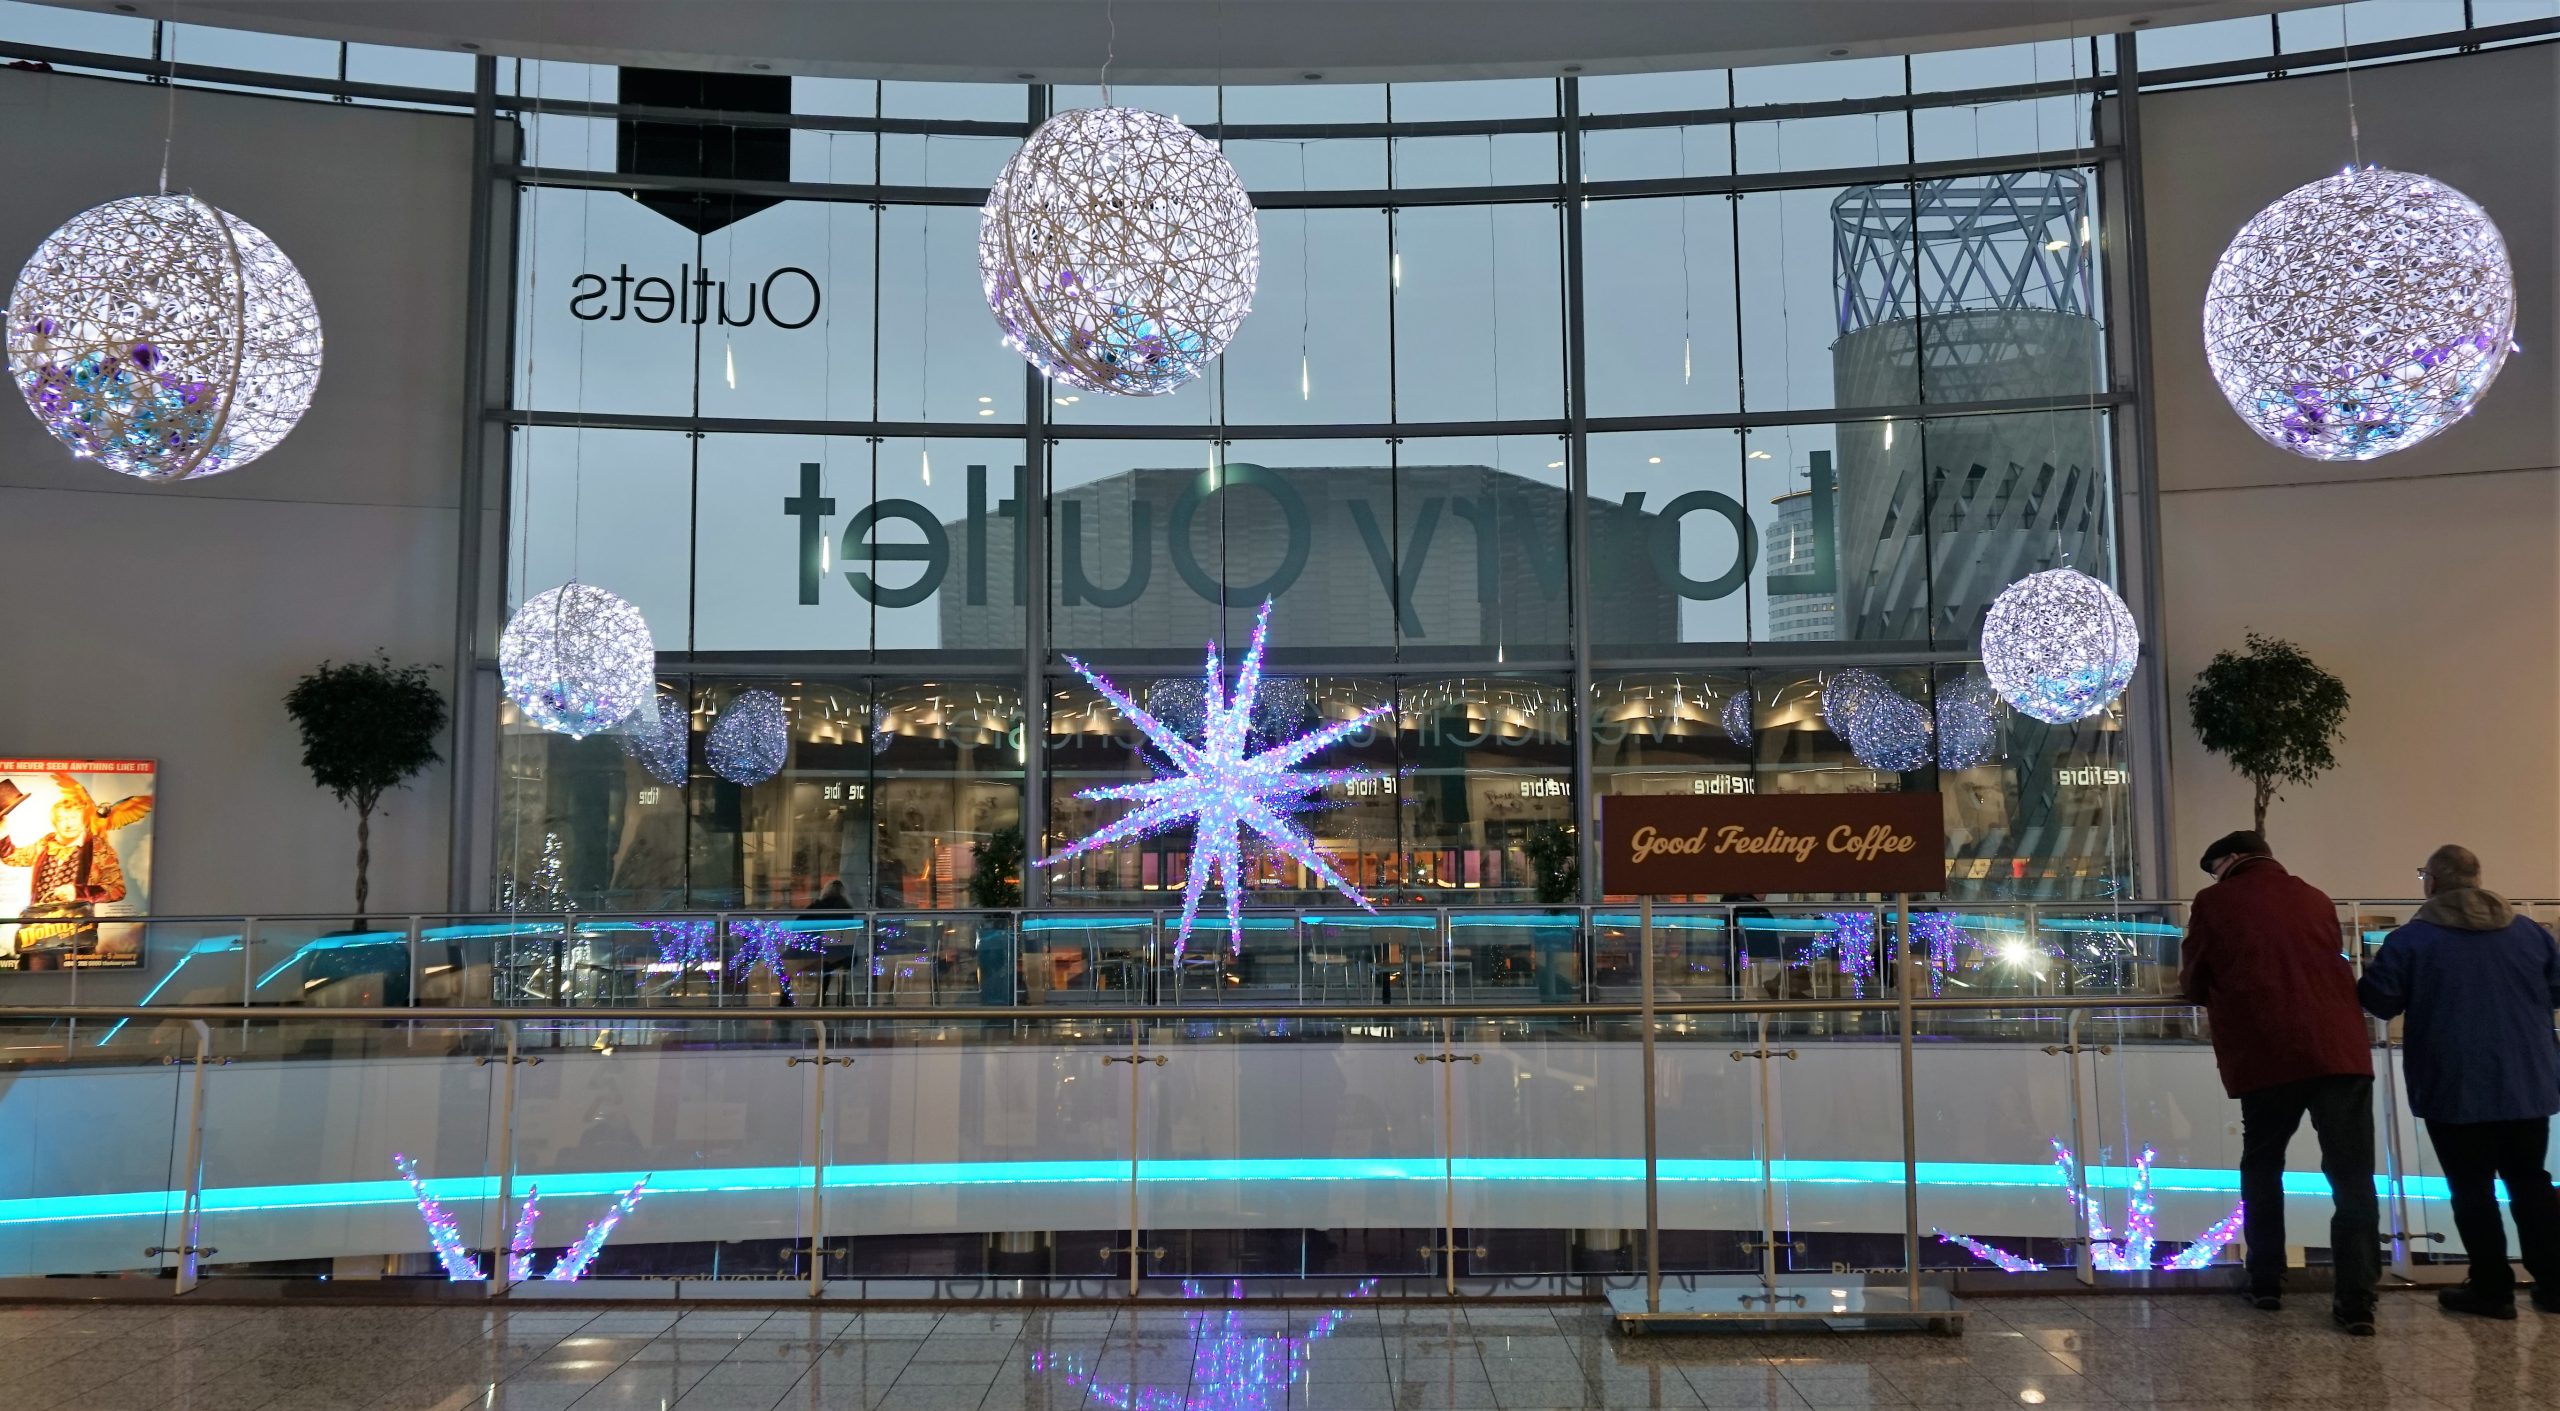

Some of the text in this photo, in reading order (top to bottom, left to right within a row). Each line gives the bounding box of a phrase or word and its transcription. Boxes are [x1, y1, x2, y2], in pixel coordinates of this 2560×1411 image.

[16, 762, 44, 770] NEVER
[46, 762, 68, 770] SEEN
[69, 762, 115, 771] ANYTHING
[116, 763, 137, 771] LIKE
[1631, 824, 1918, 864] Good Feeling Coffee
